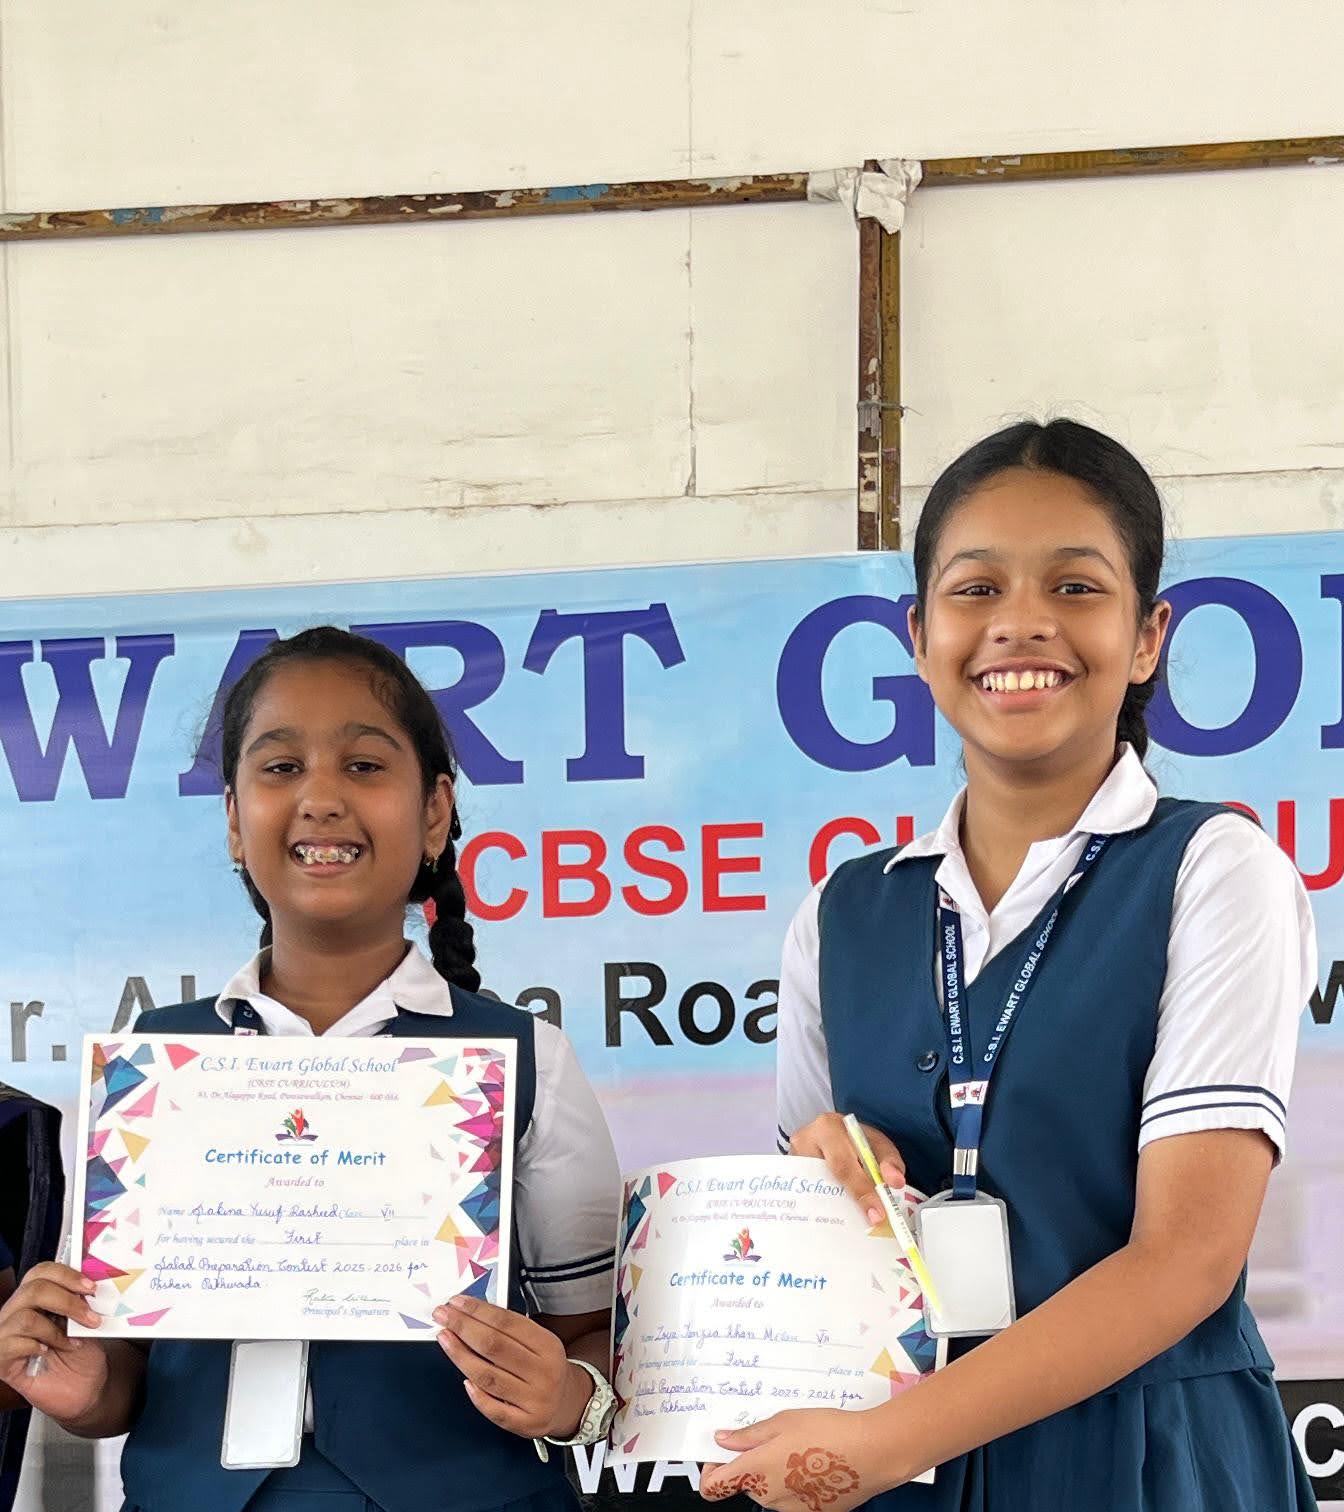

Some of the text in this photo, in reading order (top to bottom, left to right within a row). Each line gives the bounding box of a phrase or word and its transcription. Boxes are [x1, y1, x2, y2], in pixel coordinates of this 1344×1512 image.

[424, 822, 767, 928] CBSE
[945, 924, 956, 959] SCHOOL
[946, 959, 958, 998] GLOBAL
[996, 993, 1021, 1033] EWART
[1014, 949, 1042, 992] GLOBAL
[949, 1000, 962, 1037] EWART
[247, 1057, 294, 1073] Ewart
[298, 1056, 346, 1076] Global
[348, 1057, 398, 1073] School
[205, 1148, 387, 1166] Certificate of Merit
[264, 1176, 325, 1188] Awarded to
[708, 1177, 744, 1193] Ewart
[748, 1175, 797, 1195] Global
[796, 1179, 845, 1198] School
[158, 1207, 185, 1216] Name
[156, 1234, 170, 1246] for
[173, 1234, 204, 1246] having
[207, 1234, 239, 1245] secured
[393, 1236, 419, 1249] place
[420, 1238, 430, 1247] in
[670, 1270, 828, 1290] Certificate of Merit
[827, 1365, 853, 1377] place
[854, 1370, 865, 1378] in
